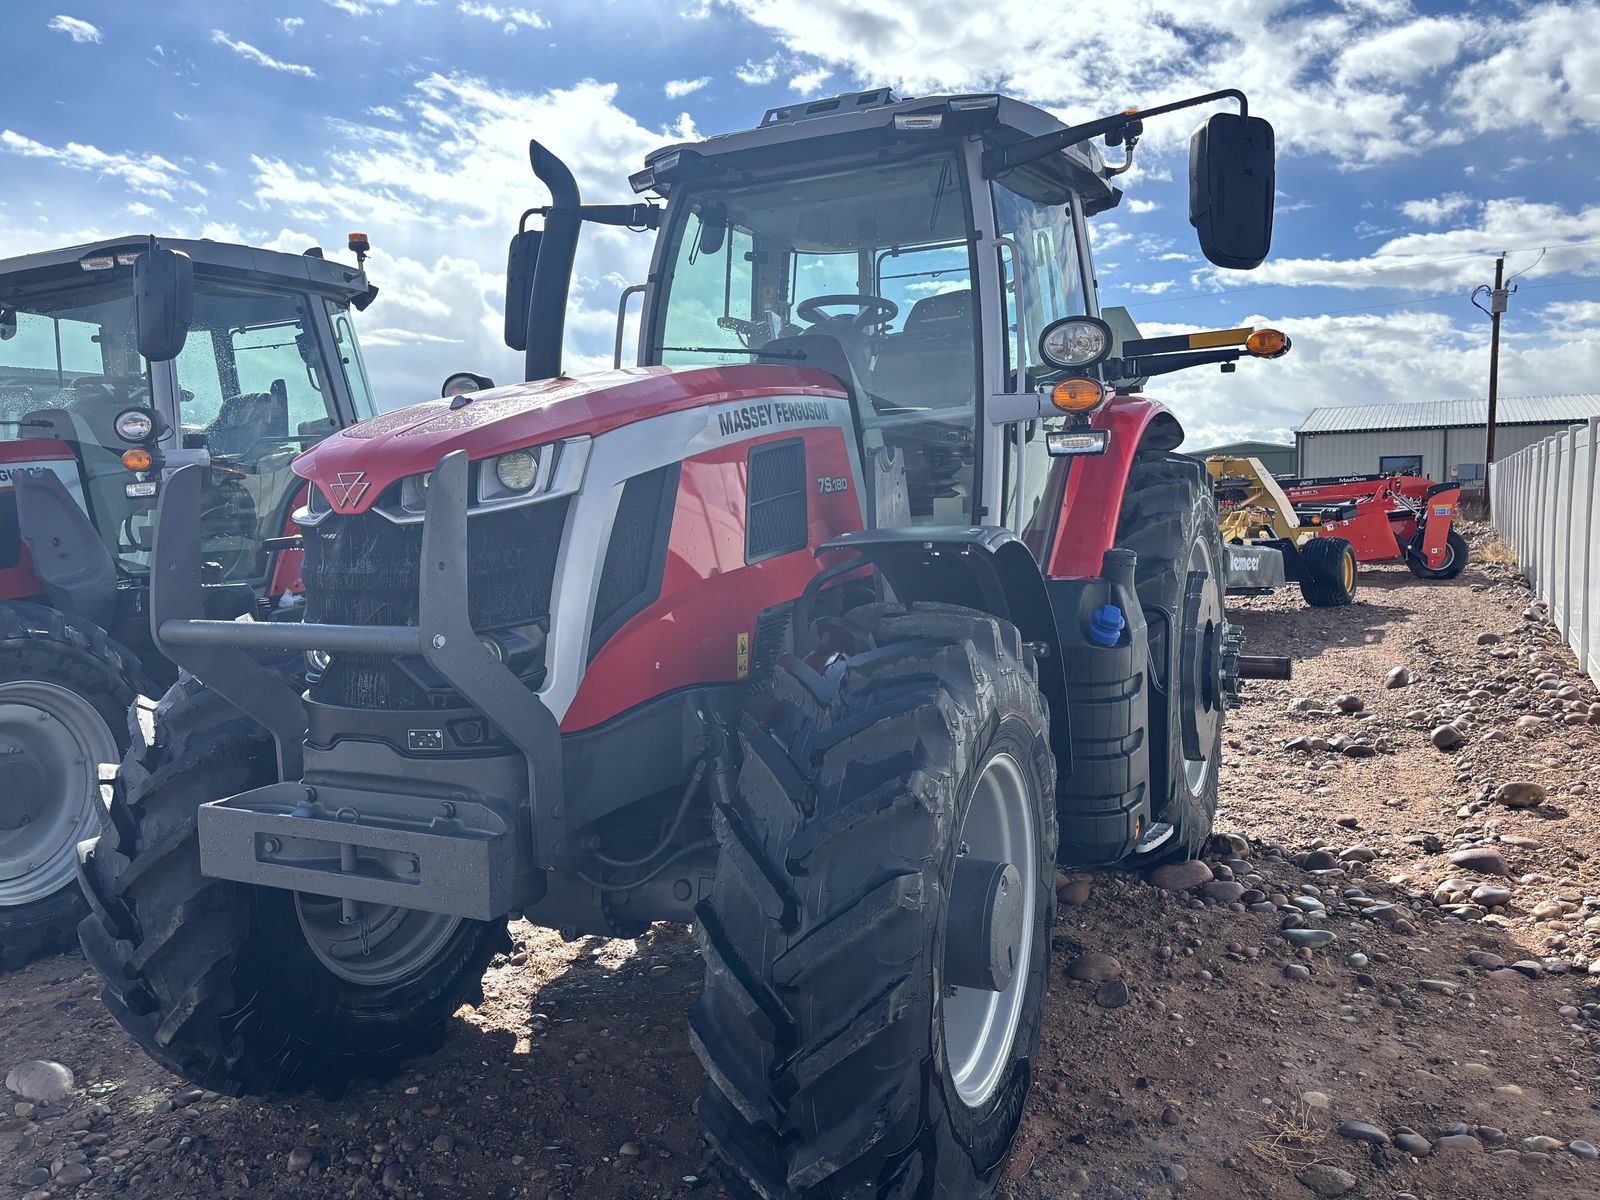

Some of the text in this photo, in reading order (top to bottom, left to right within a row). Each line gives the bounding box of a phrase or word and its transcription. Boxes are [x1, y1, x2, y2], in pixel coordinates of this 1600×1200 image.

[717, 401, 830, 436] MASSEY FERGUSON
[1338, 476, 1367, 484] MacDon
